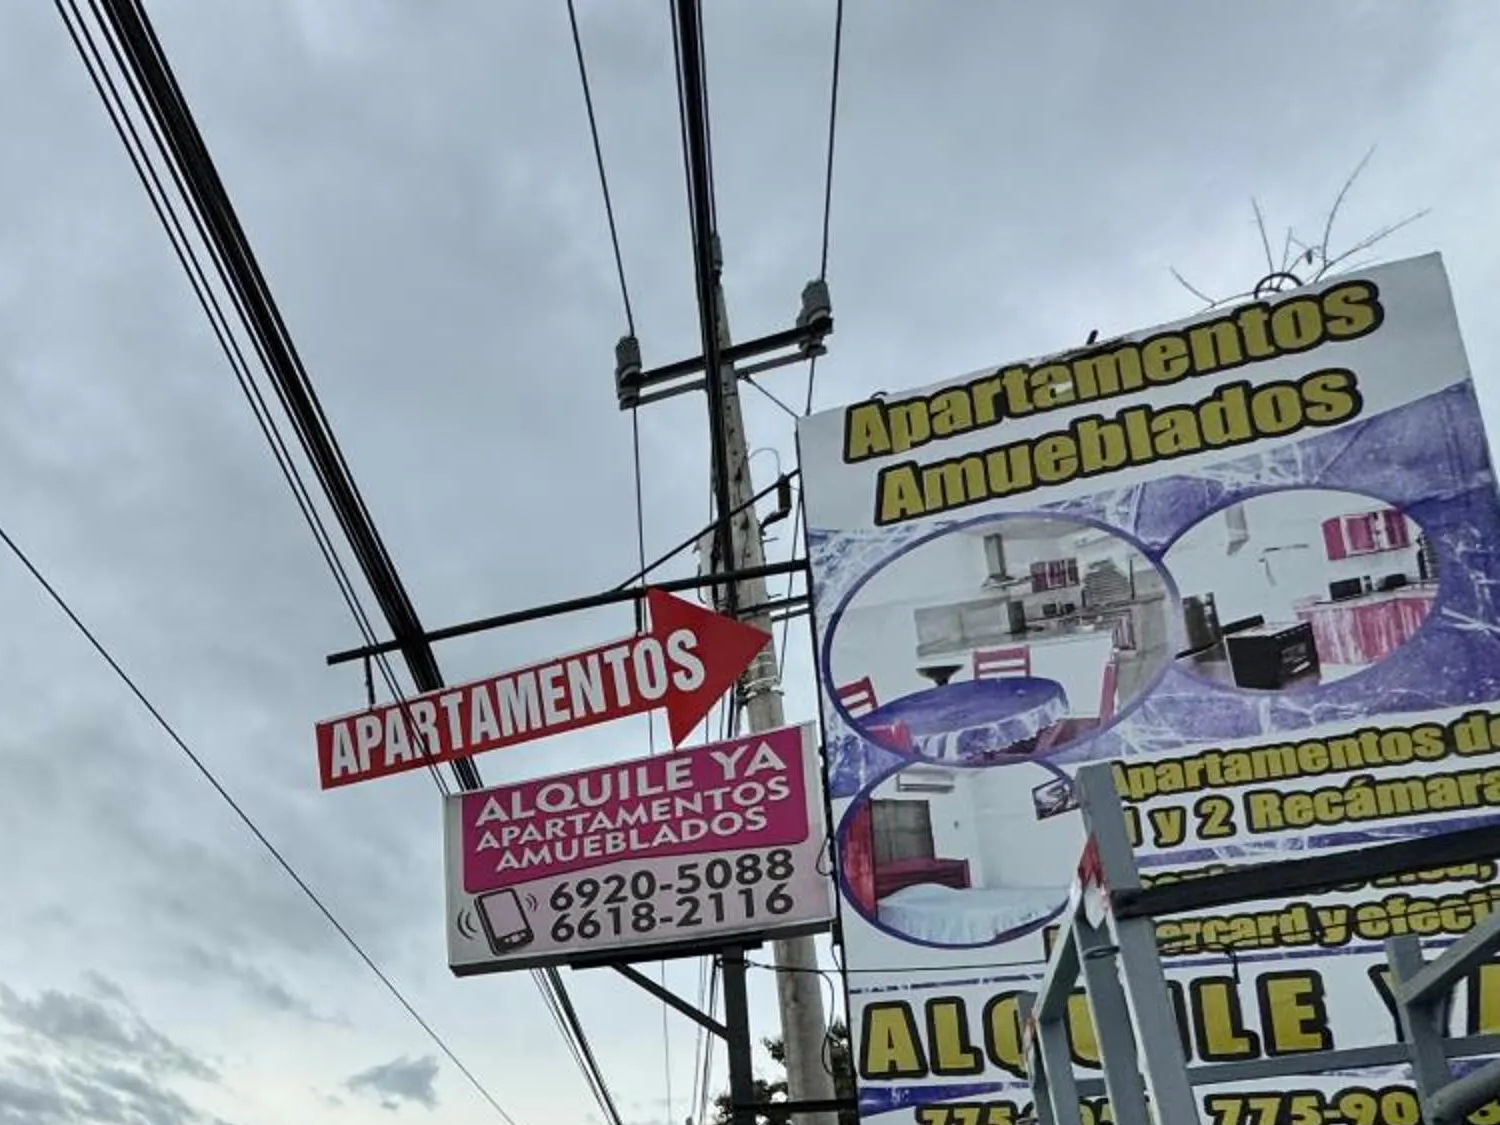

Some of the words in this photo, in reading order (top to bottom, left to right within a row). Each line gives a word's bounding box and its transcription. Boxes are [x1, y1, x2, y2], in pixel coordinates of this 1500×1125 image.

[844, 280, 1384, 463] Apartamentos
[873, 369, 1366, 526] Amueblados
[331, 629, 706, 778] APARTAMENTOS
[475, 757, 694, 827] ALQUILE
[710, 741, 787, 782] YA
[475, 775, 790, 852] APARTAMENTOS
[1147, 806, 1187, 848] y
[1195, 796, 1236, 839] 2
[496, 806, 768, 873] AMUEBLADOS
[550, 849, 794, 912] 6920-5088
[550, 883, 794, 942] 6618-2116
[1312, 905, 1353, 946] y
[860, 969, 1333, 1080] ALQLE
